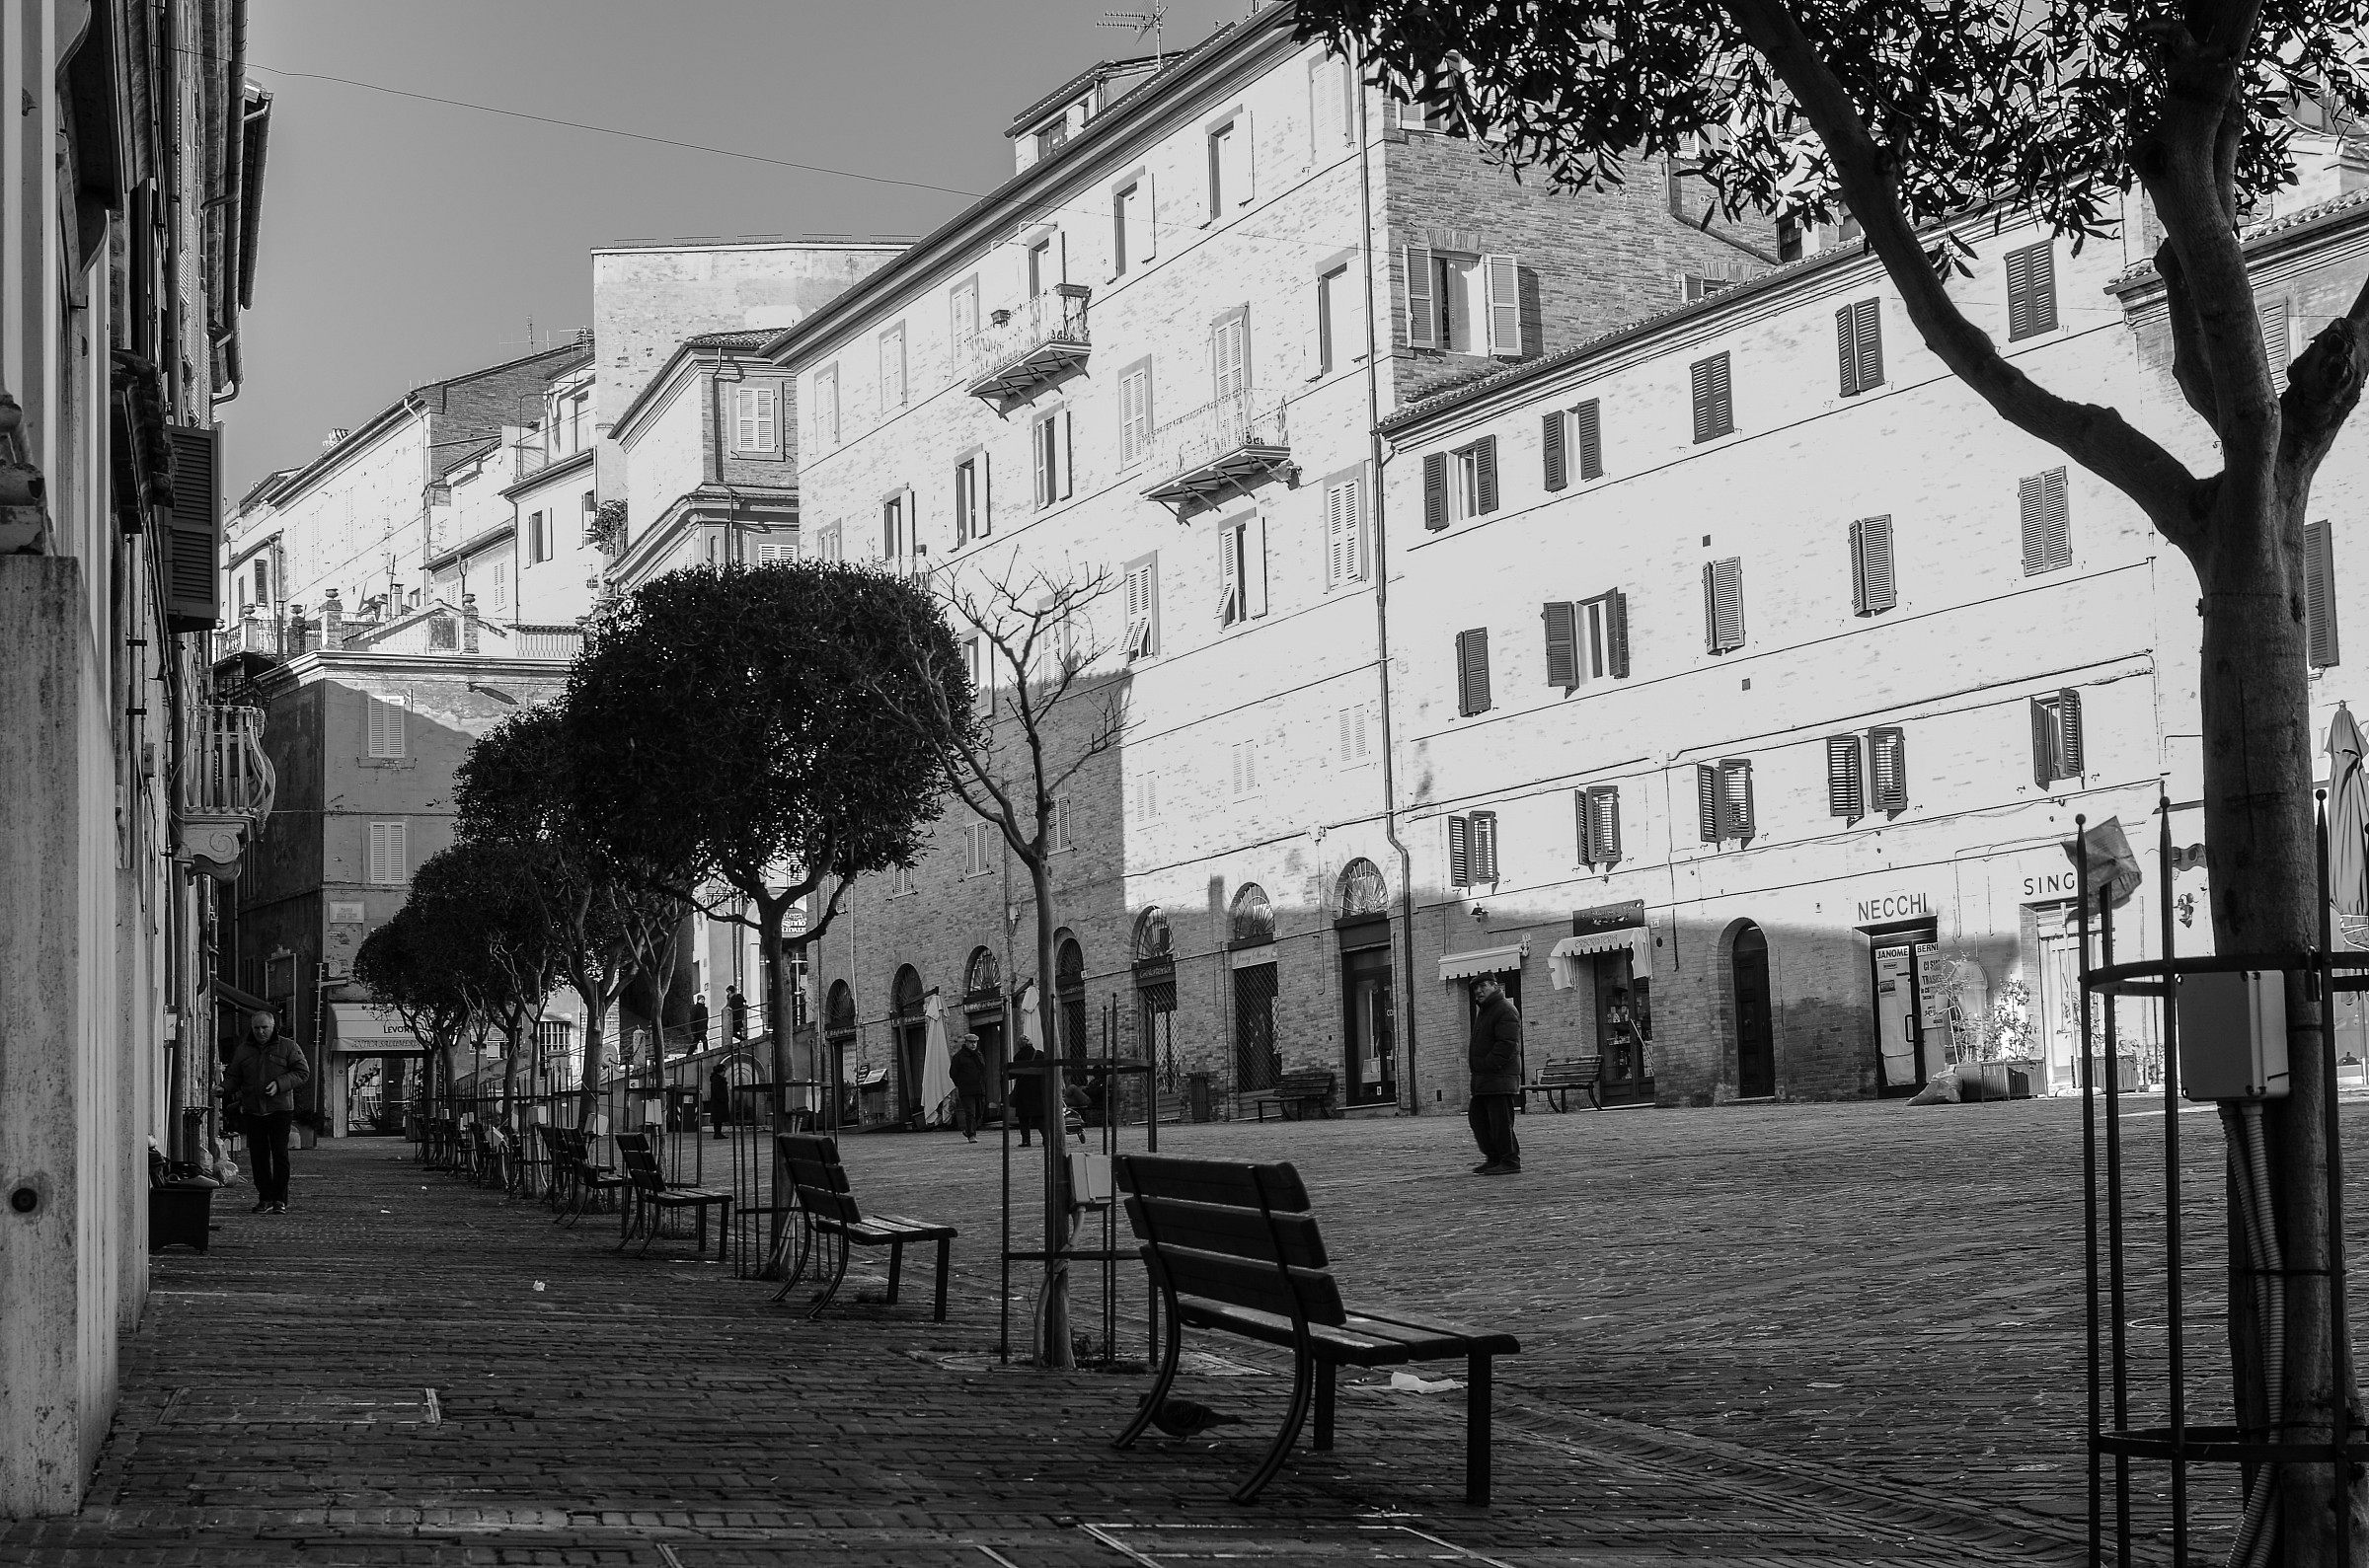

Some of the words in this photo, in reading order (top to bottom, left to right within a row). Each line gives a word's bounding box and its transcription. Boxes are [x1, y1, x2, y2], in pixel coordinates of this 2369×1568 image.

[2023, 872, 2075, 896] SING
[1858, 892, 1928, 922] NECCHI
[1876, 948, 1908, 959] JANOME
[1917, 943, 1939, 953] BERNI
